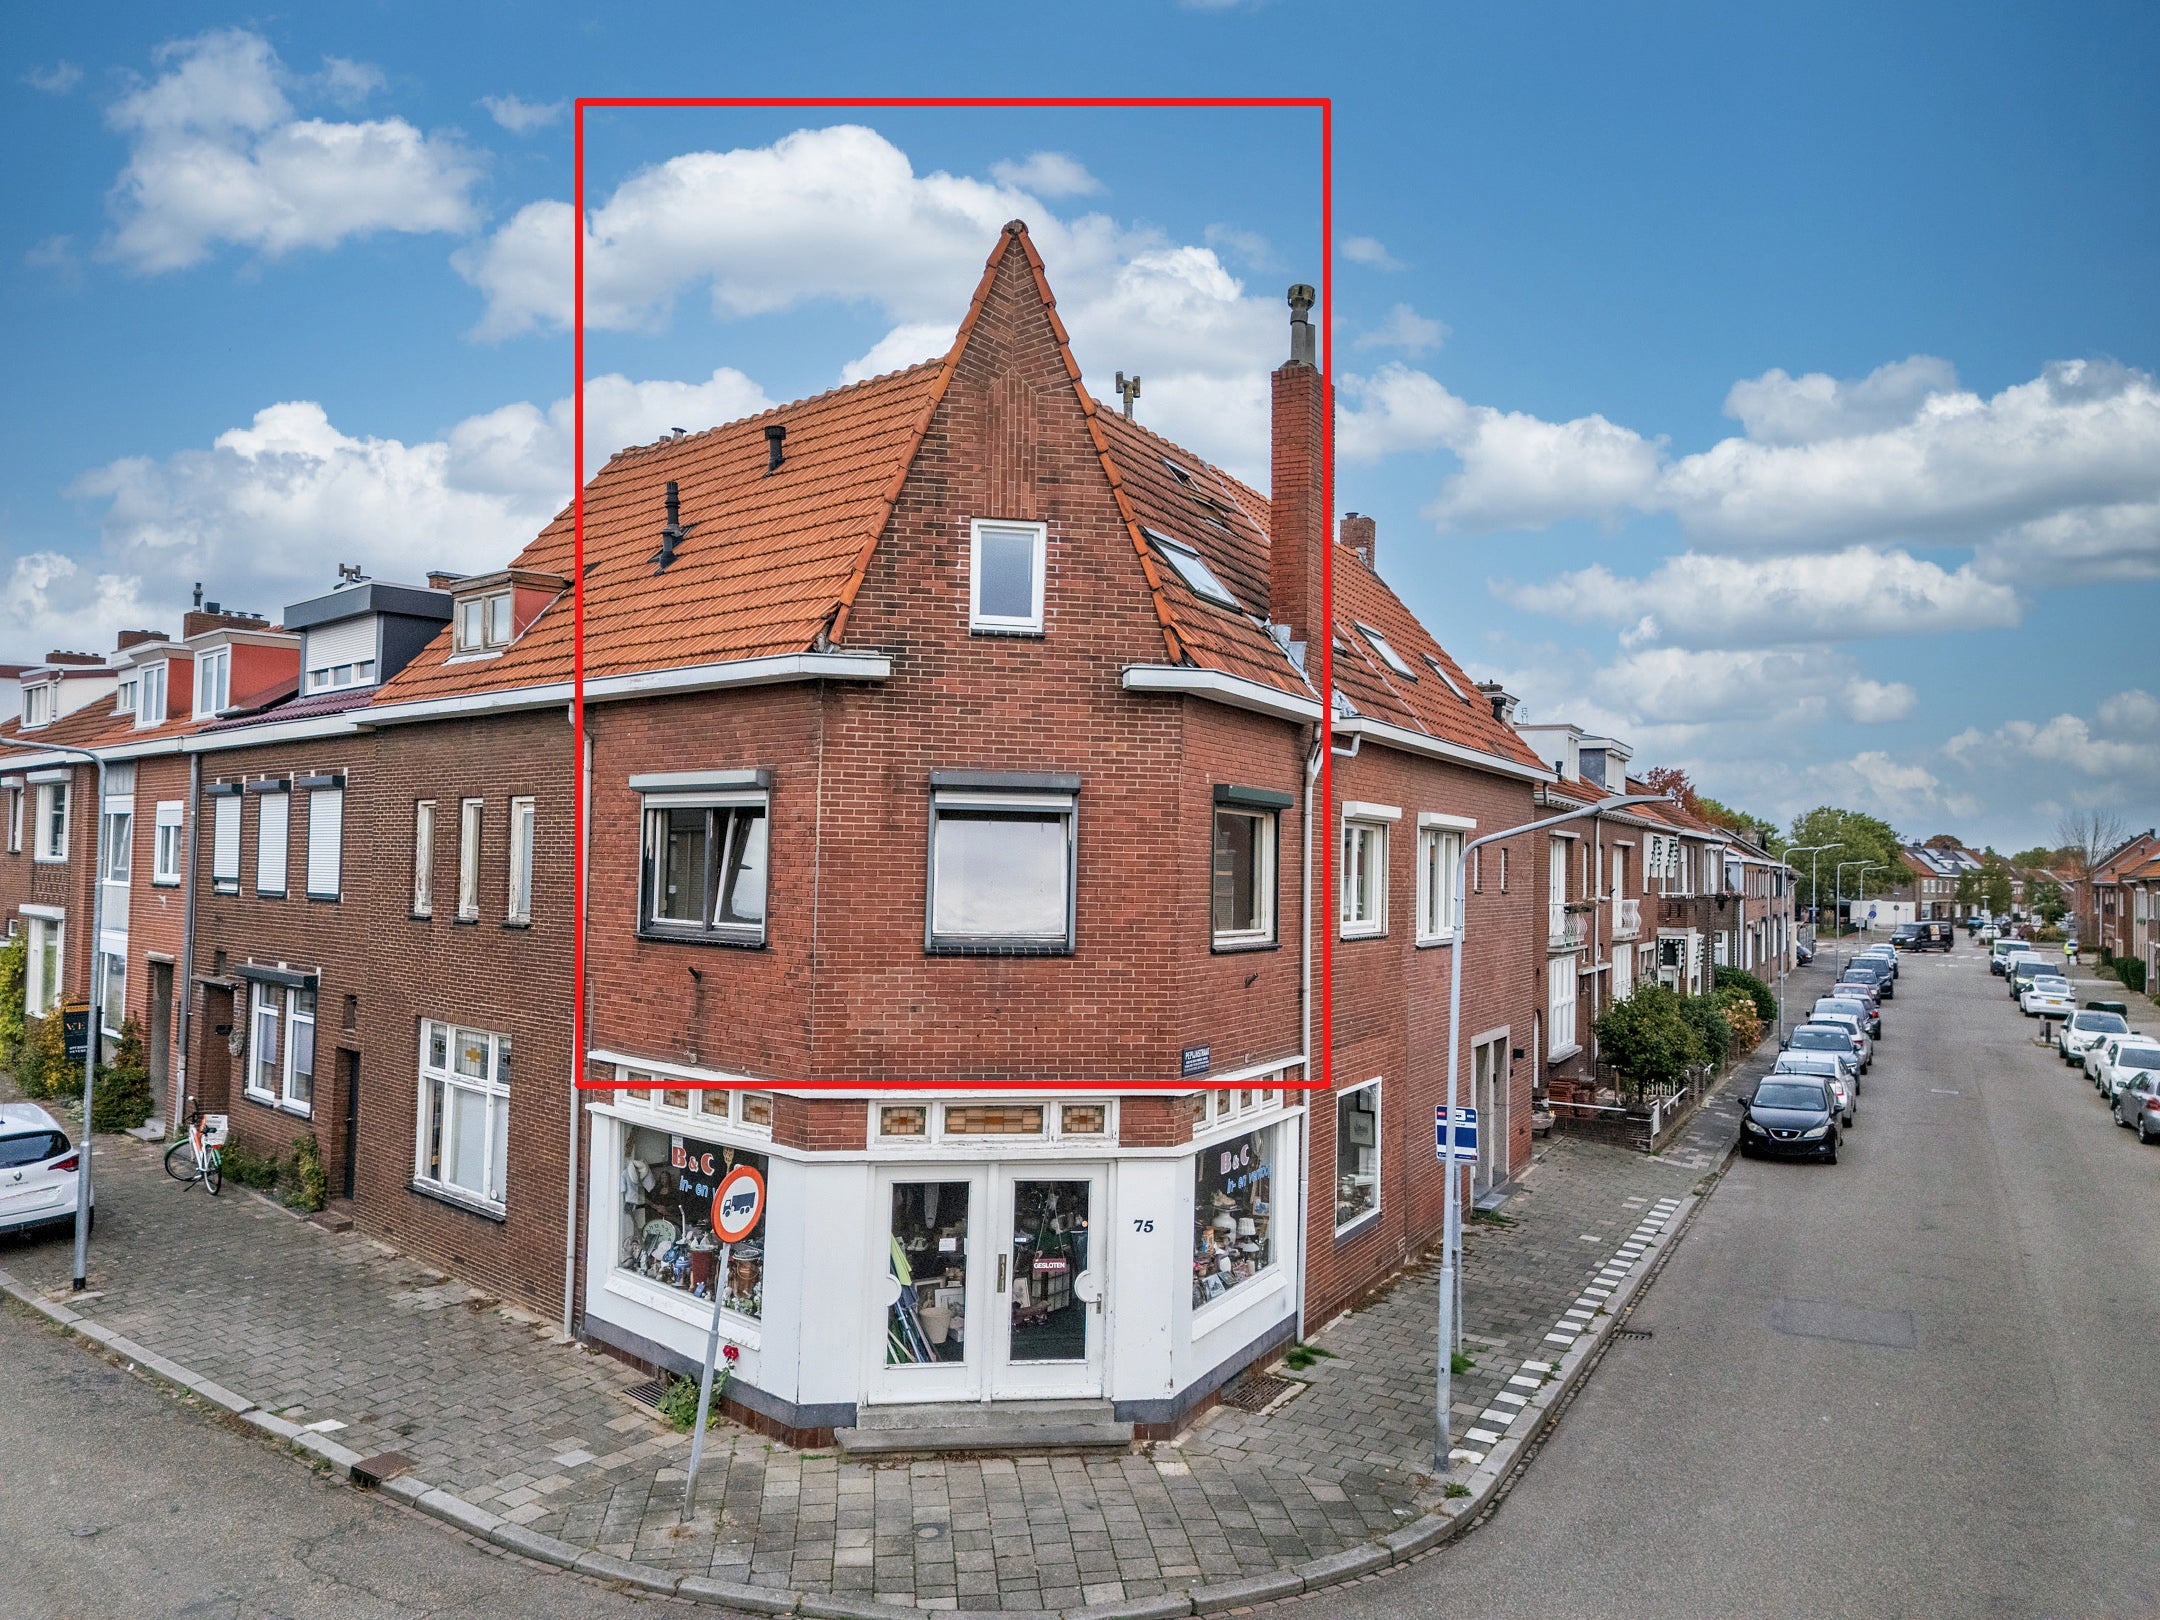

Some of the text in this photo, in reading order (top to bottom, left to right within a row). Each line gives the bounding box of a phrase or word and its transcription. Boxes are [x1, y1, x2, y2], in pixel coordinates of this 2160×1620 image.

[671, 1146, 715, 1176] B & C
[1220, 1144, 1249, 1175] B & C
[1238, 1174, 1247, 1188] en
[695, 1183, 709, 1197] en
[1133, 1219, 1154, 1233] 75
[1033, 1261, 1066, 1269] GESLOTEN
